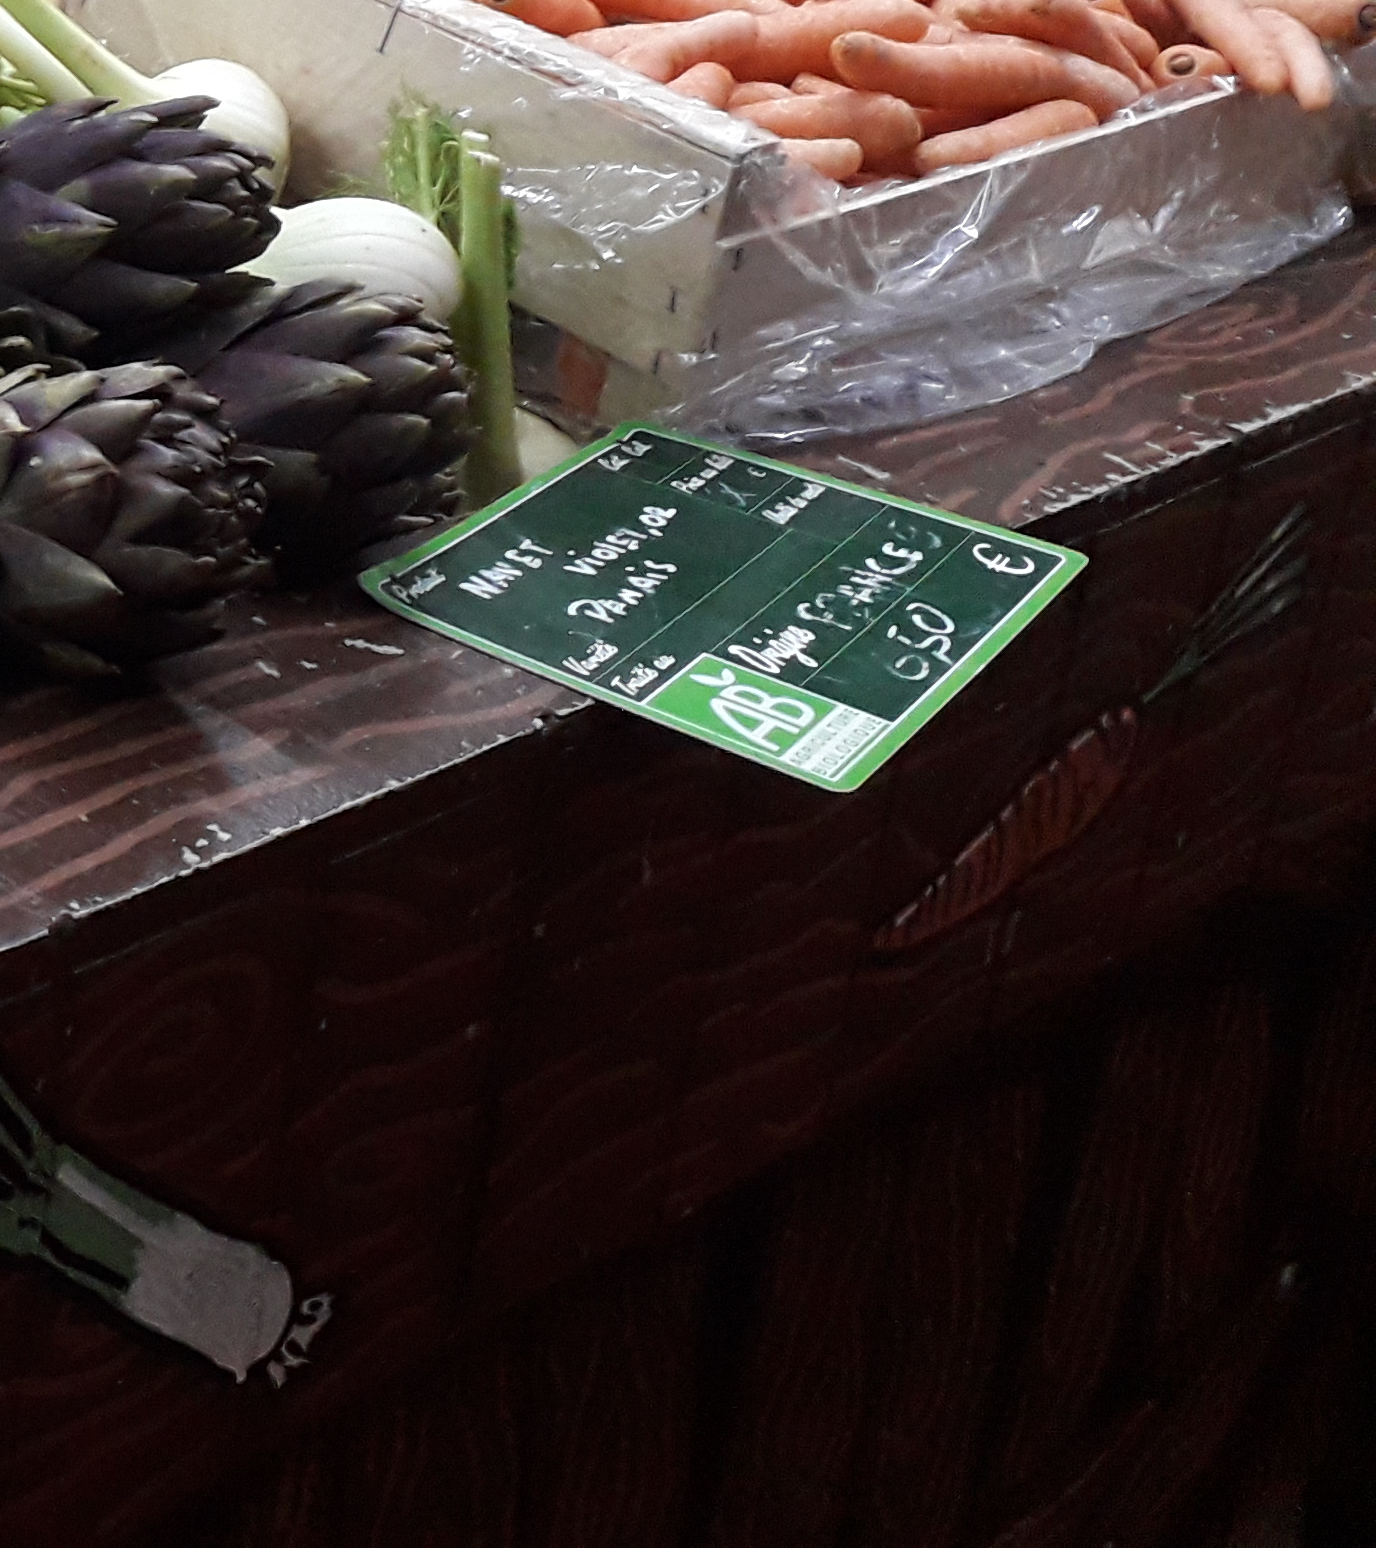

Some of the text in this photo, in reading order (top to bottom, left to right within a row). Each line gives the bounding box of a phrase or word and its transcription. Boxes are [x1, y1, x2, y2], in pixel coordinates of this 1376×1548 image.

[459, 538, 554, 600] NAVET
[972, 542, 1036, 575] €
[709, 683, 817, 753] AB
